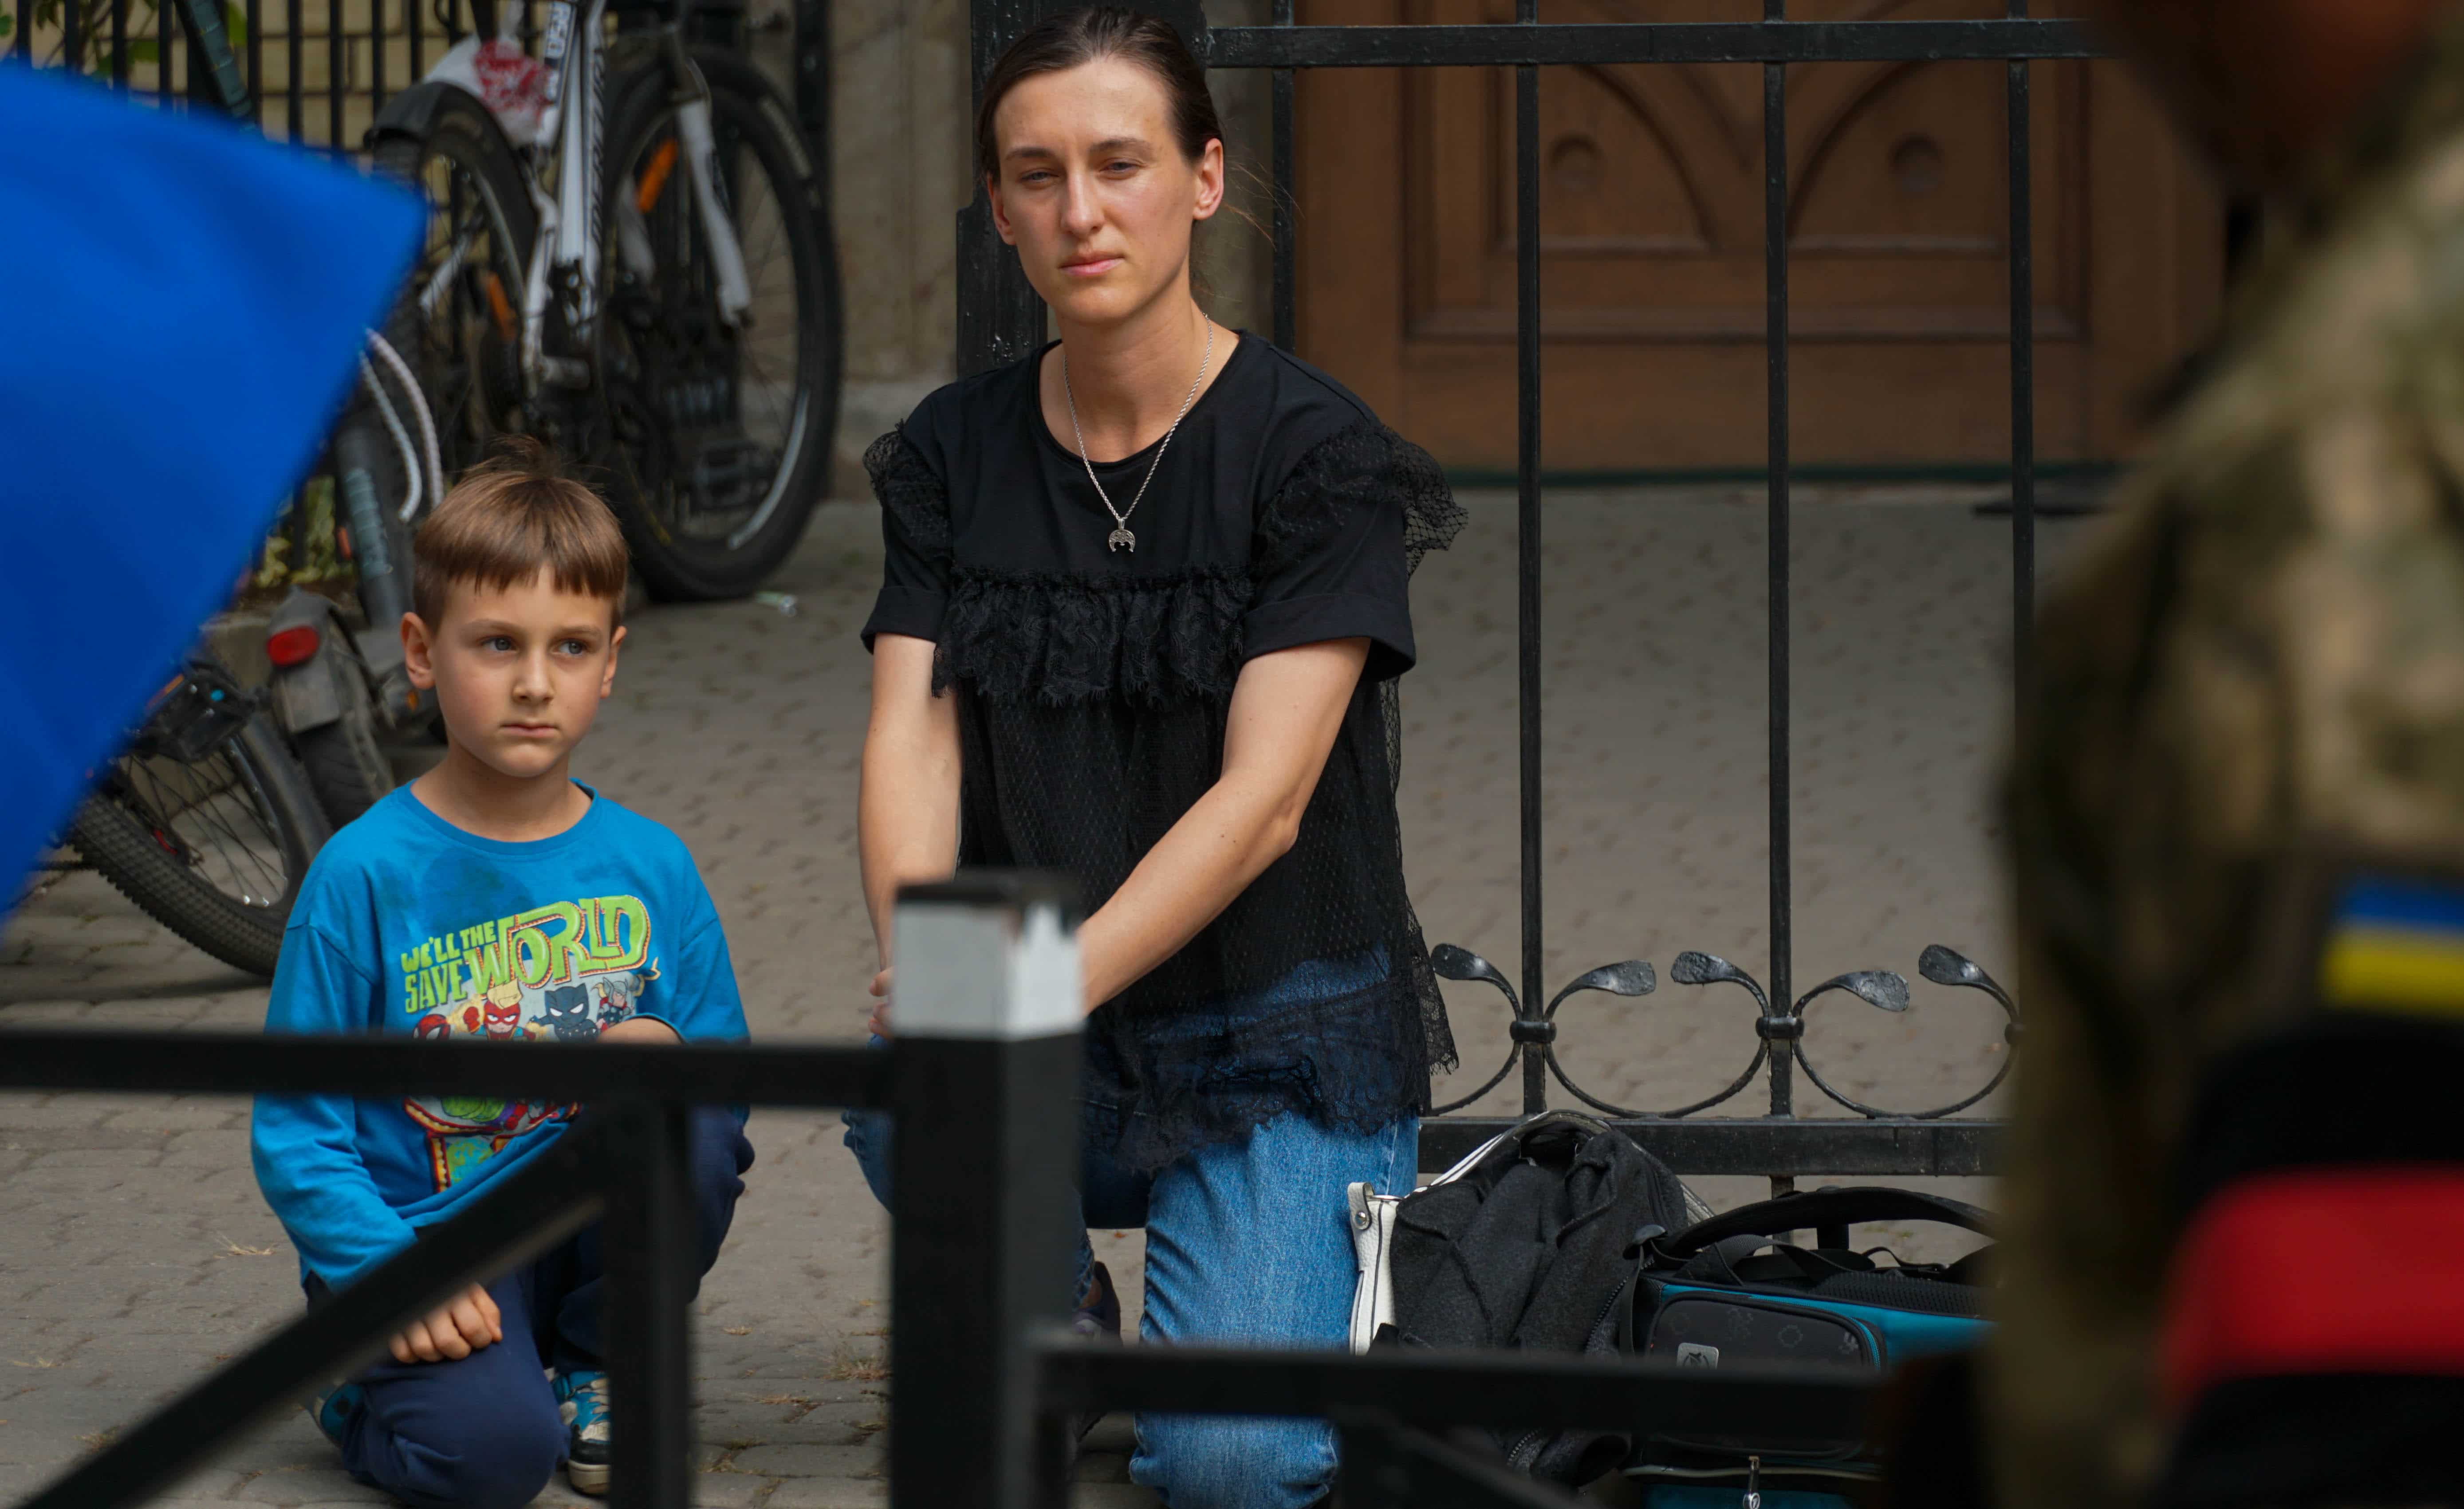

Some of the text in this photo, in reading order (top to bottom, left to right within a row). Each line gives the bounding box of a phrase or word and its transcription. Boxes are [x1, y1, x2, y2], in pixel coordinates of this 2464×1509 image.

[401, 921, 496, 973] WE'LL THE
[405, 895, 650, 1013] SAVE WORLD
